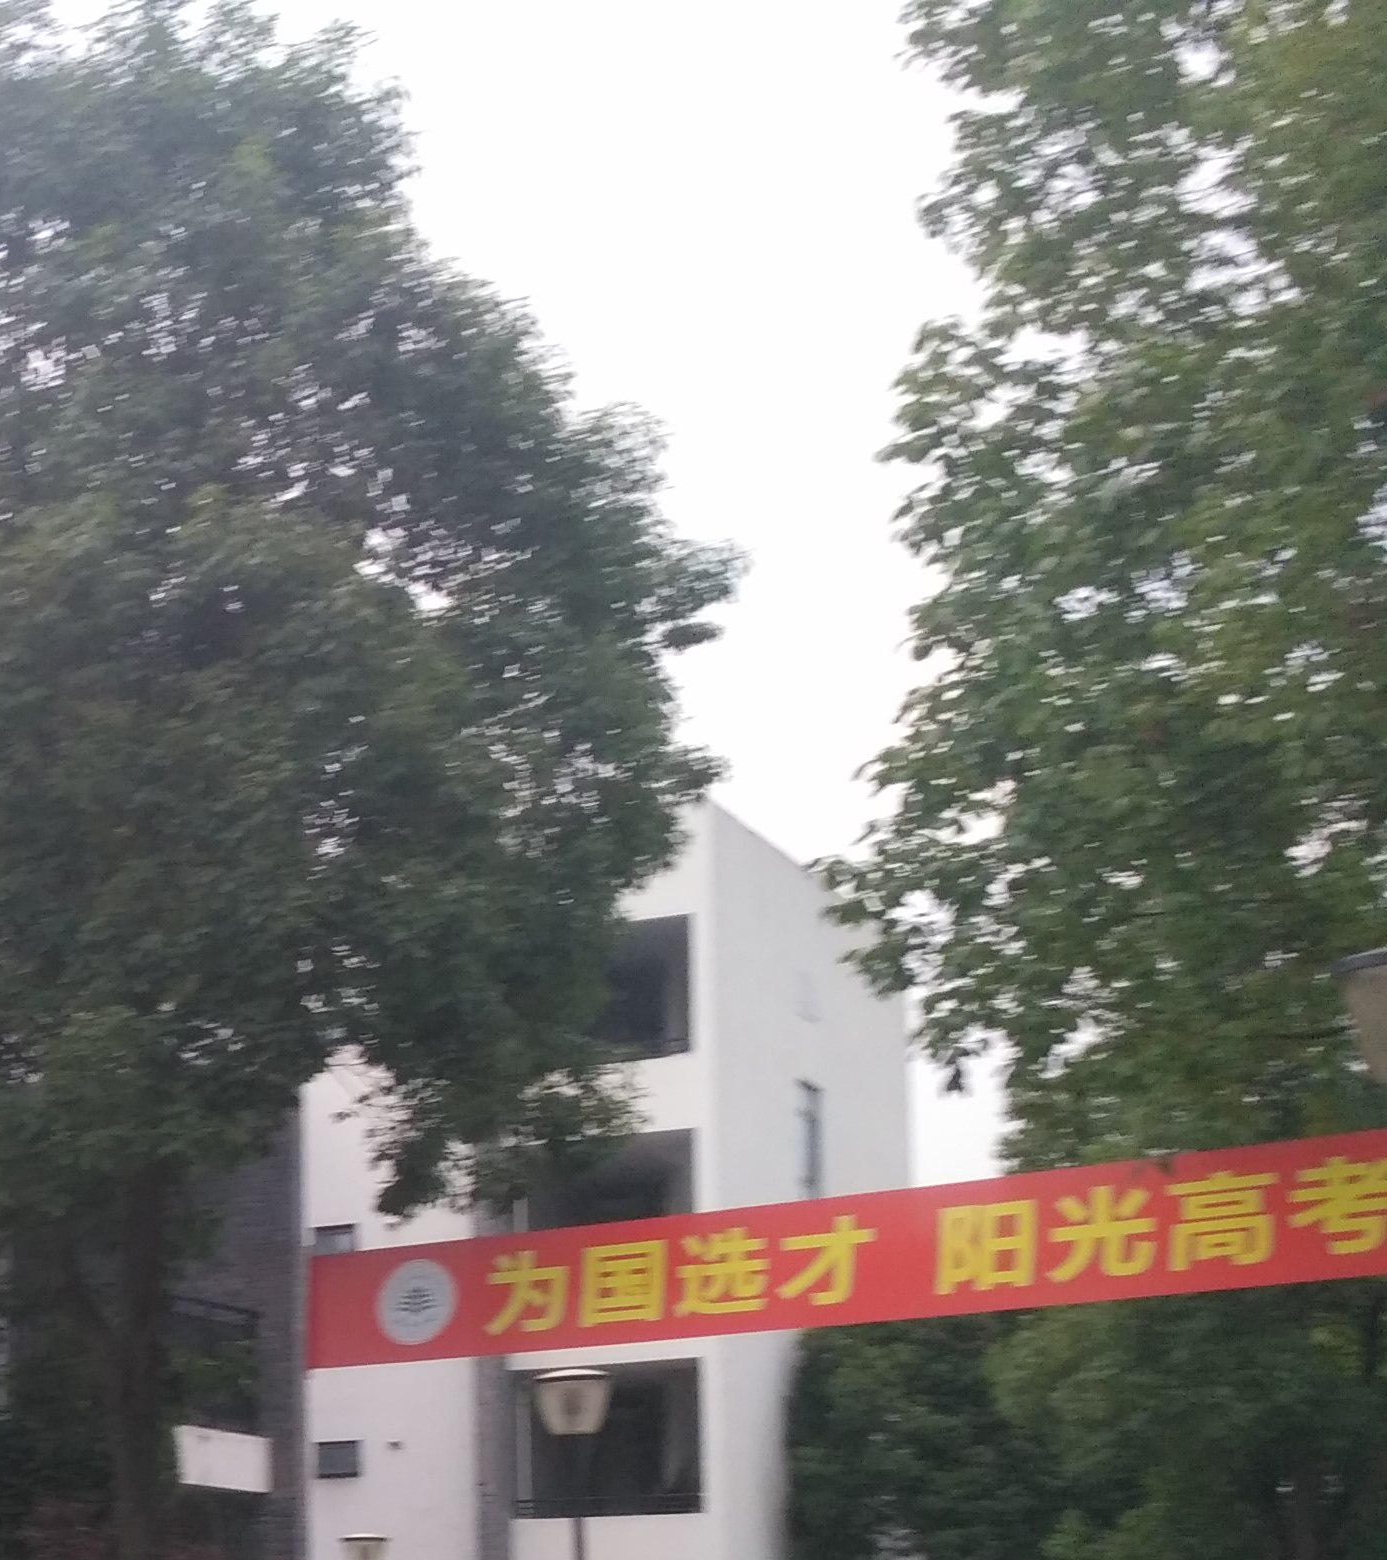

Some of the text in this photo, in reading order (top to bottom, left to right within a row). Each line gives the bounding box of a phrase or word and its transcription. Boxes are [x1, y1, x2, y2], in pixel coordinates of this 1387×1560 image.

[486, 1156, 1387, 1335] 为国选才 阳光高考
